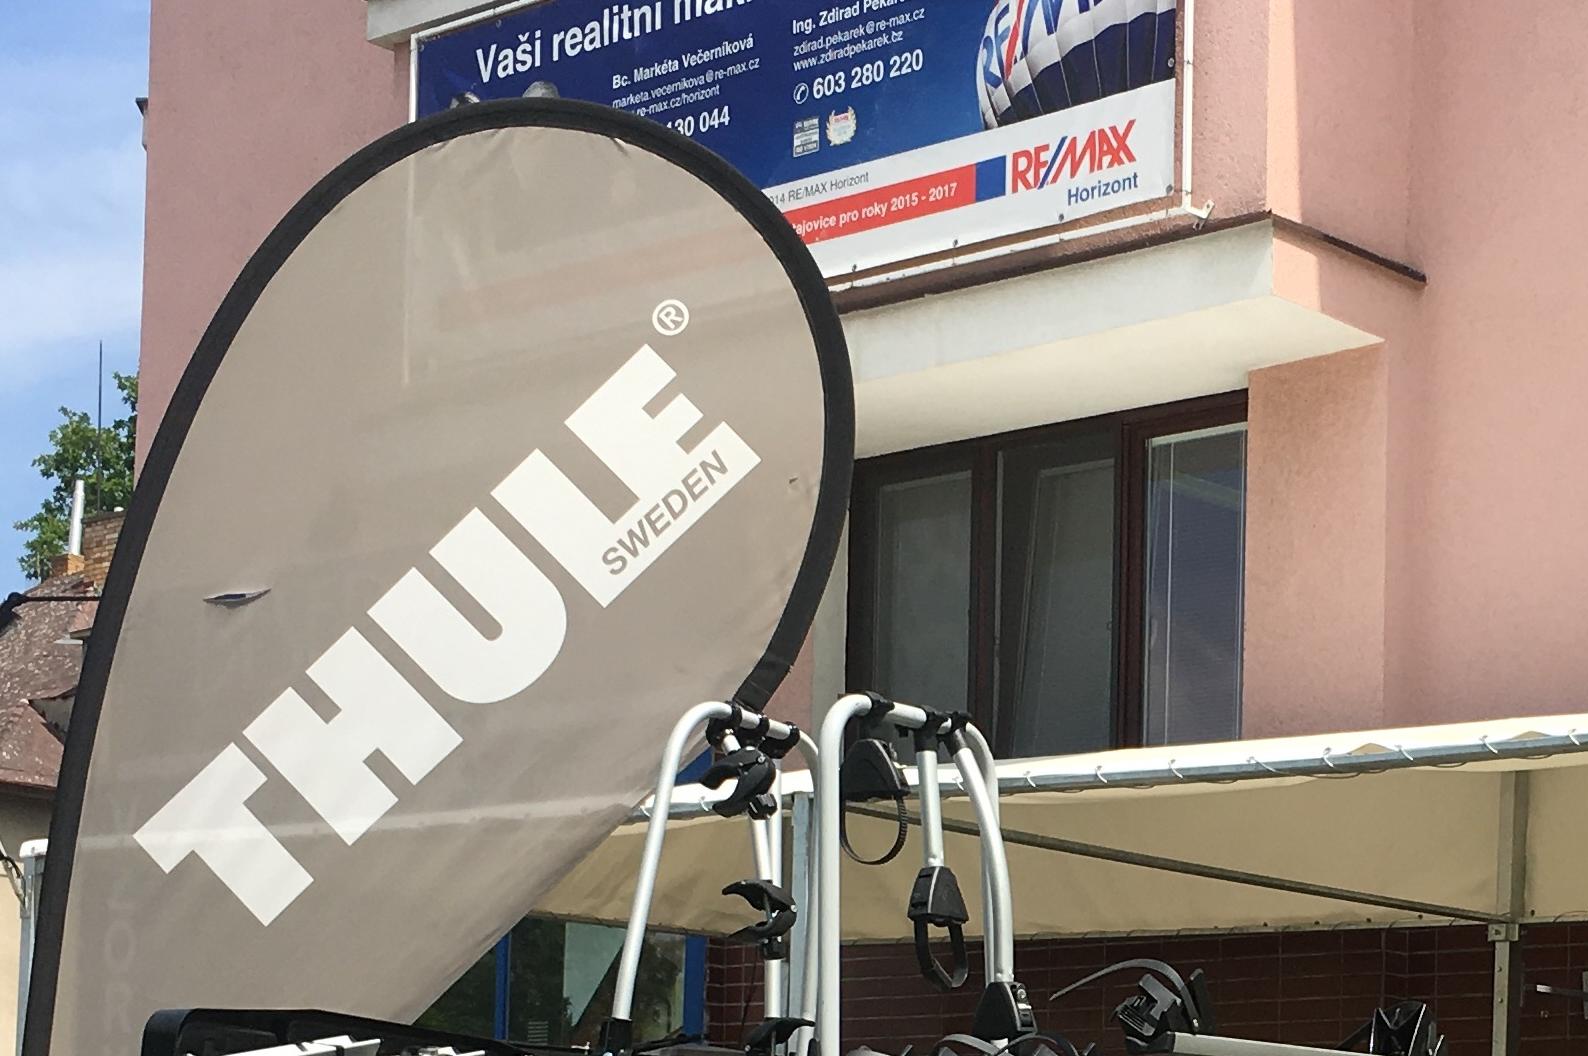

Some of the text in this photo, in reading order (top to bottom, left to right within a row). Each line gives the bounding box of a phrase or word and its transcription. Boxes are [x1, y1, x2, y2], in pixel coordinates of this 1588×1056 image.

[476, 28, 542, 84] Vaši
[552, 0, 662, 62] realitní
[792, 19, 816, 35] Ing.
[818, 1, 860, 27] Zdirad
[793, 7, 925, 57] zdirad.pekarek@re-max.cz
[612, 33, 754, 89] Bc. Markéta Večerníková
[812, 48, 924, 99] 603 280 220
[699, 105, 730, 133] 044
[1011, 118, 1137, 194] RE/MAX
[788, 182, 828, 203] RE/MAX
[830, 171, 869, 192] Horizont
[839, 207, 859, 226] pro
[861, 200, 888, 222] roky
[890, 193, 919, 212] 2015
[929, 182, 958, 203] 2017
[1067, 171, 1138, 206] Horizont
[600, 447, 731, 577] SWEDEN
[132, 343, 763, 927] THULE
